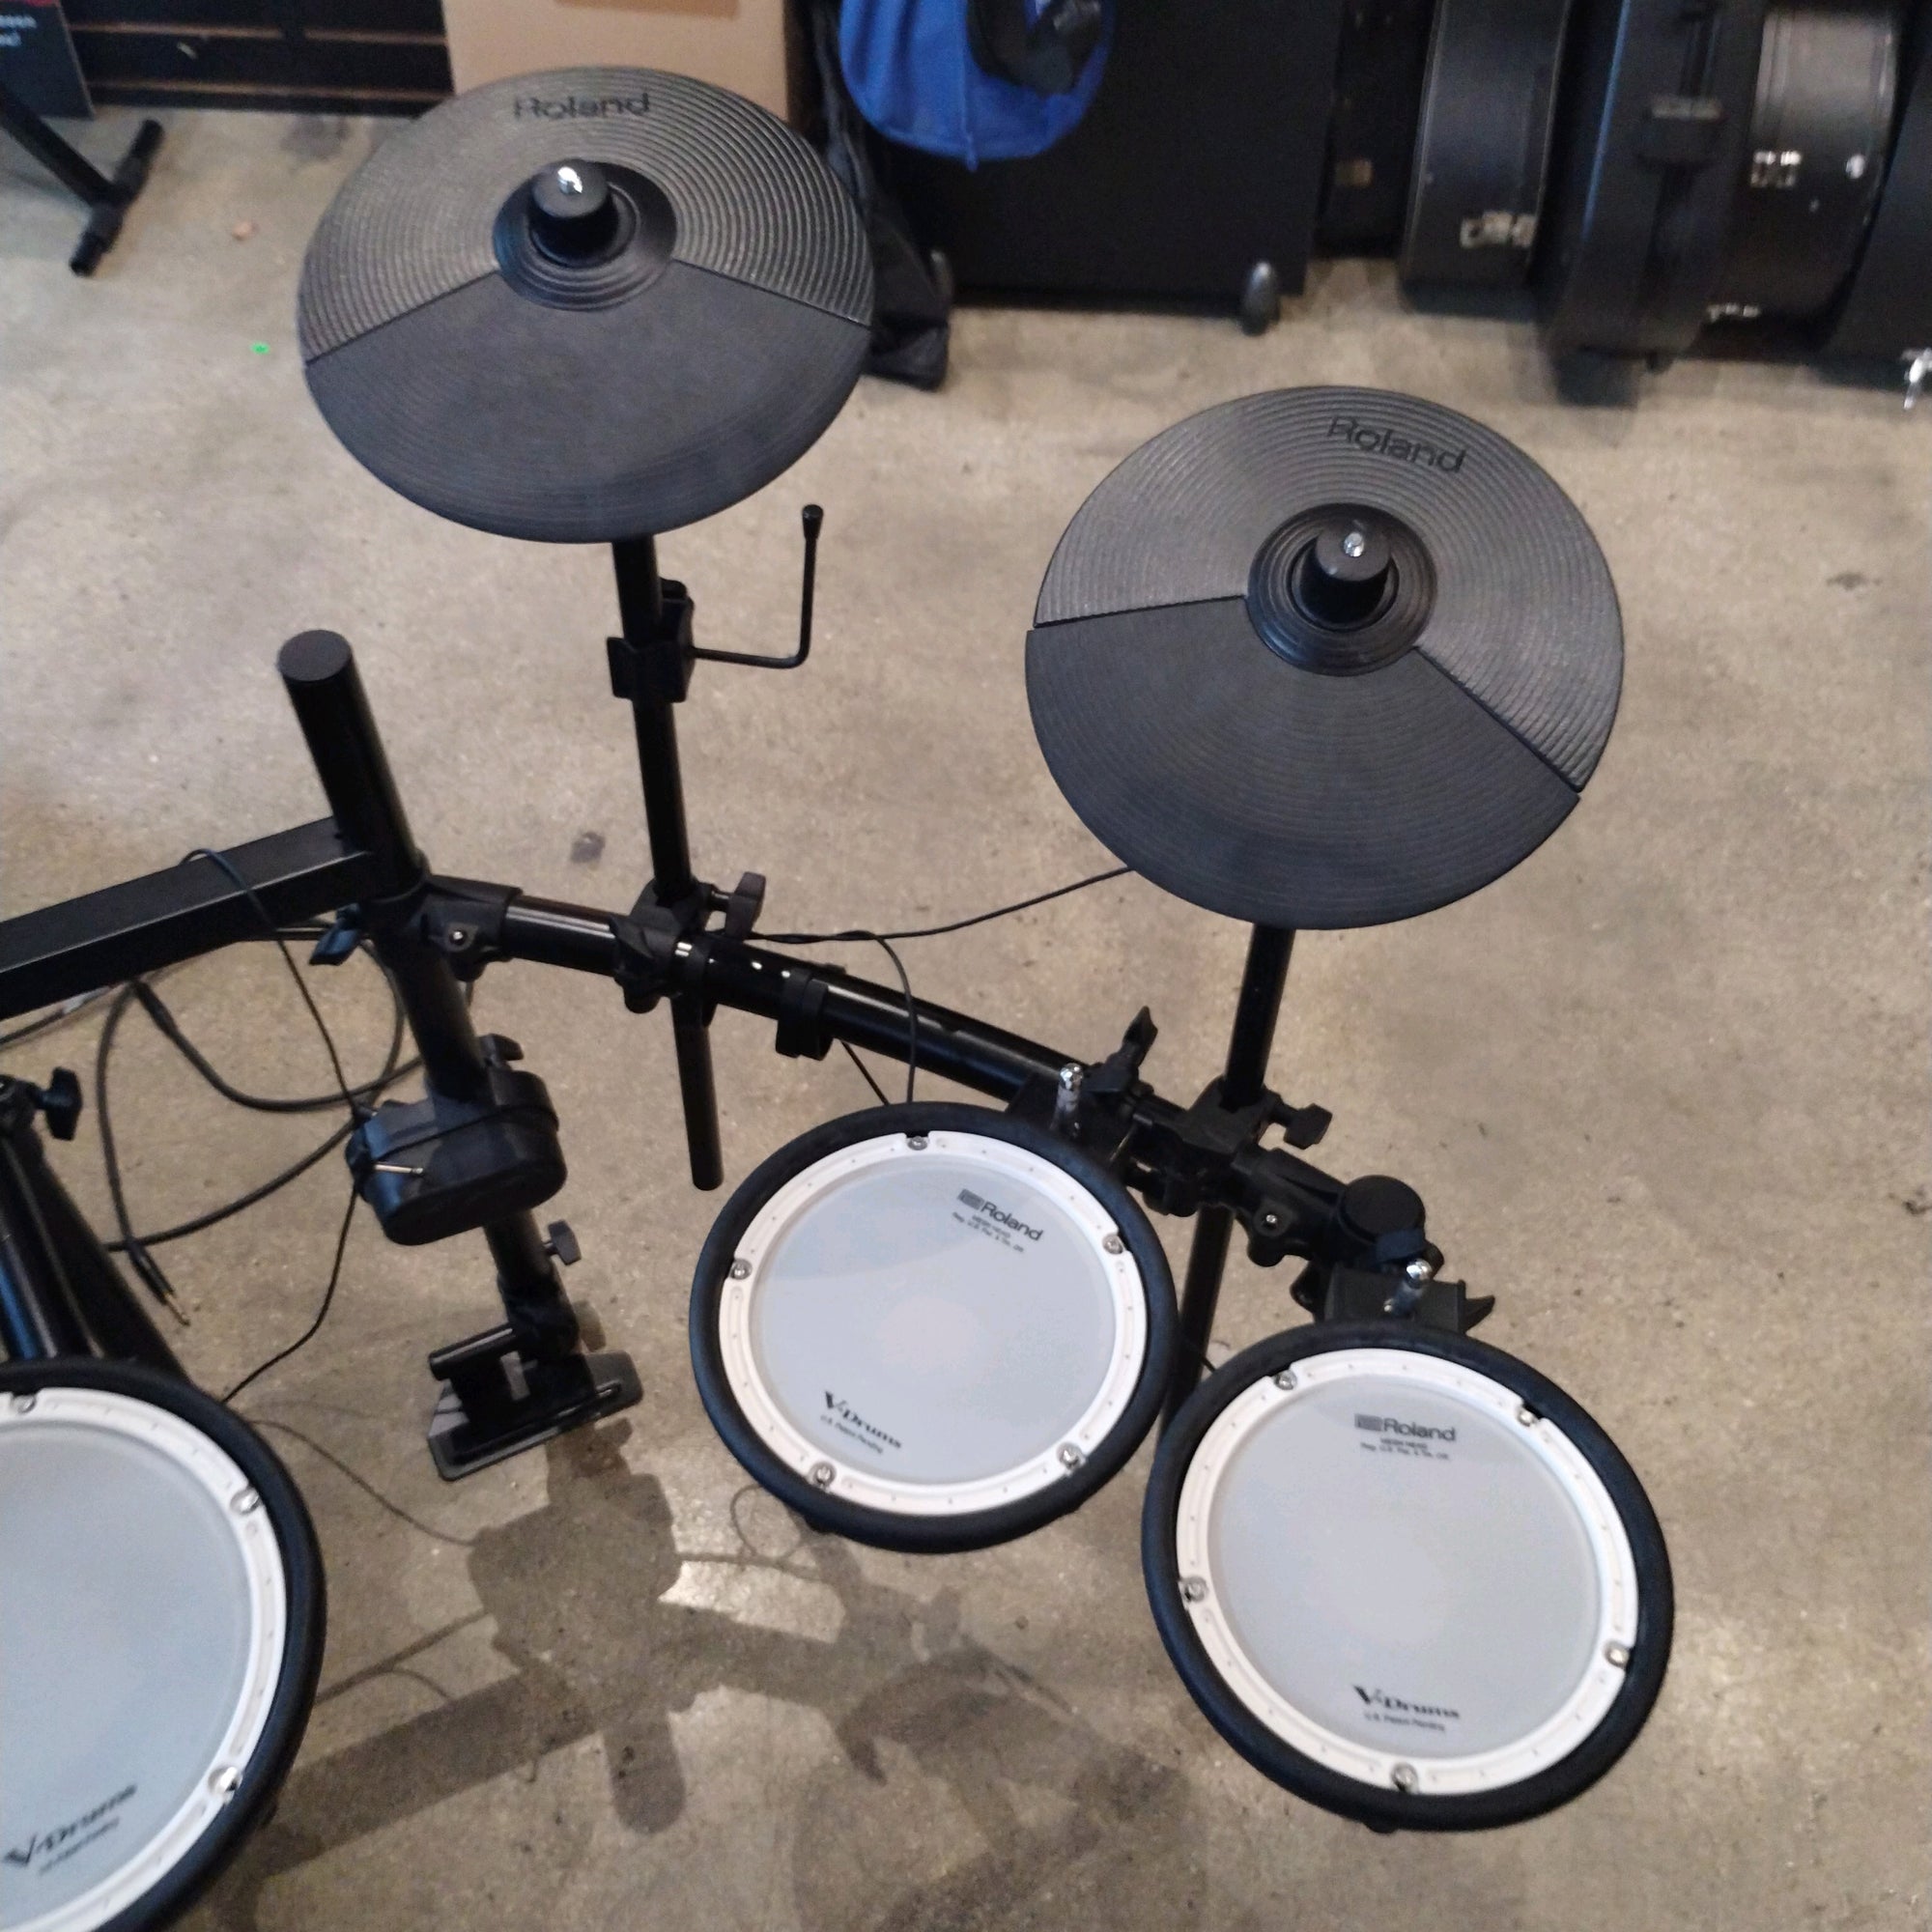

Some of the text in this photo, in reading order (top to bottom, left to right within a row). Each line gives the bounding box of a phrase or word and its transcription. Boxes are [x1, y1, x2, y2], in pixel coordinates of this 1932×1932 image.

[1326, 415, 1467, 472] Roland
[980, 1201, 1044, 1241] Roland
[1383, 1417, 1457, 1441] Roland
